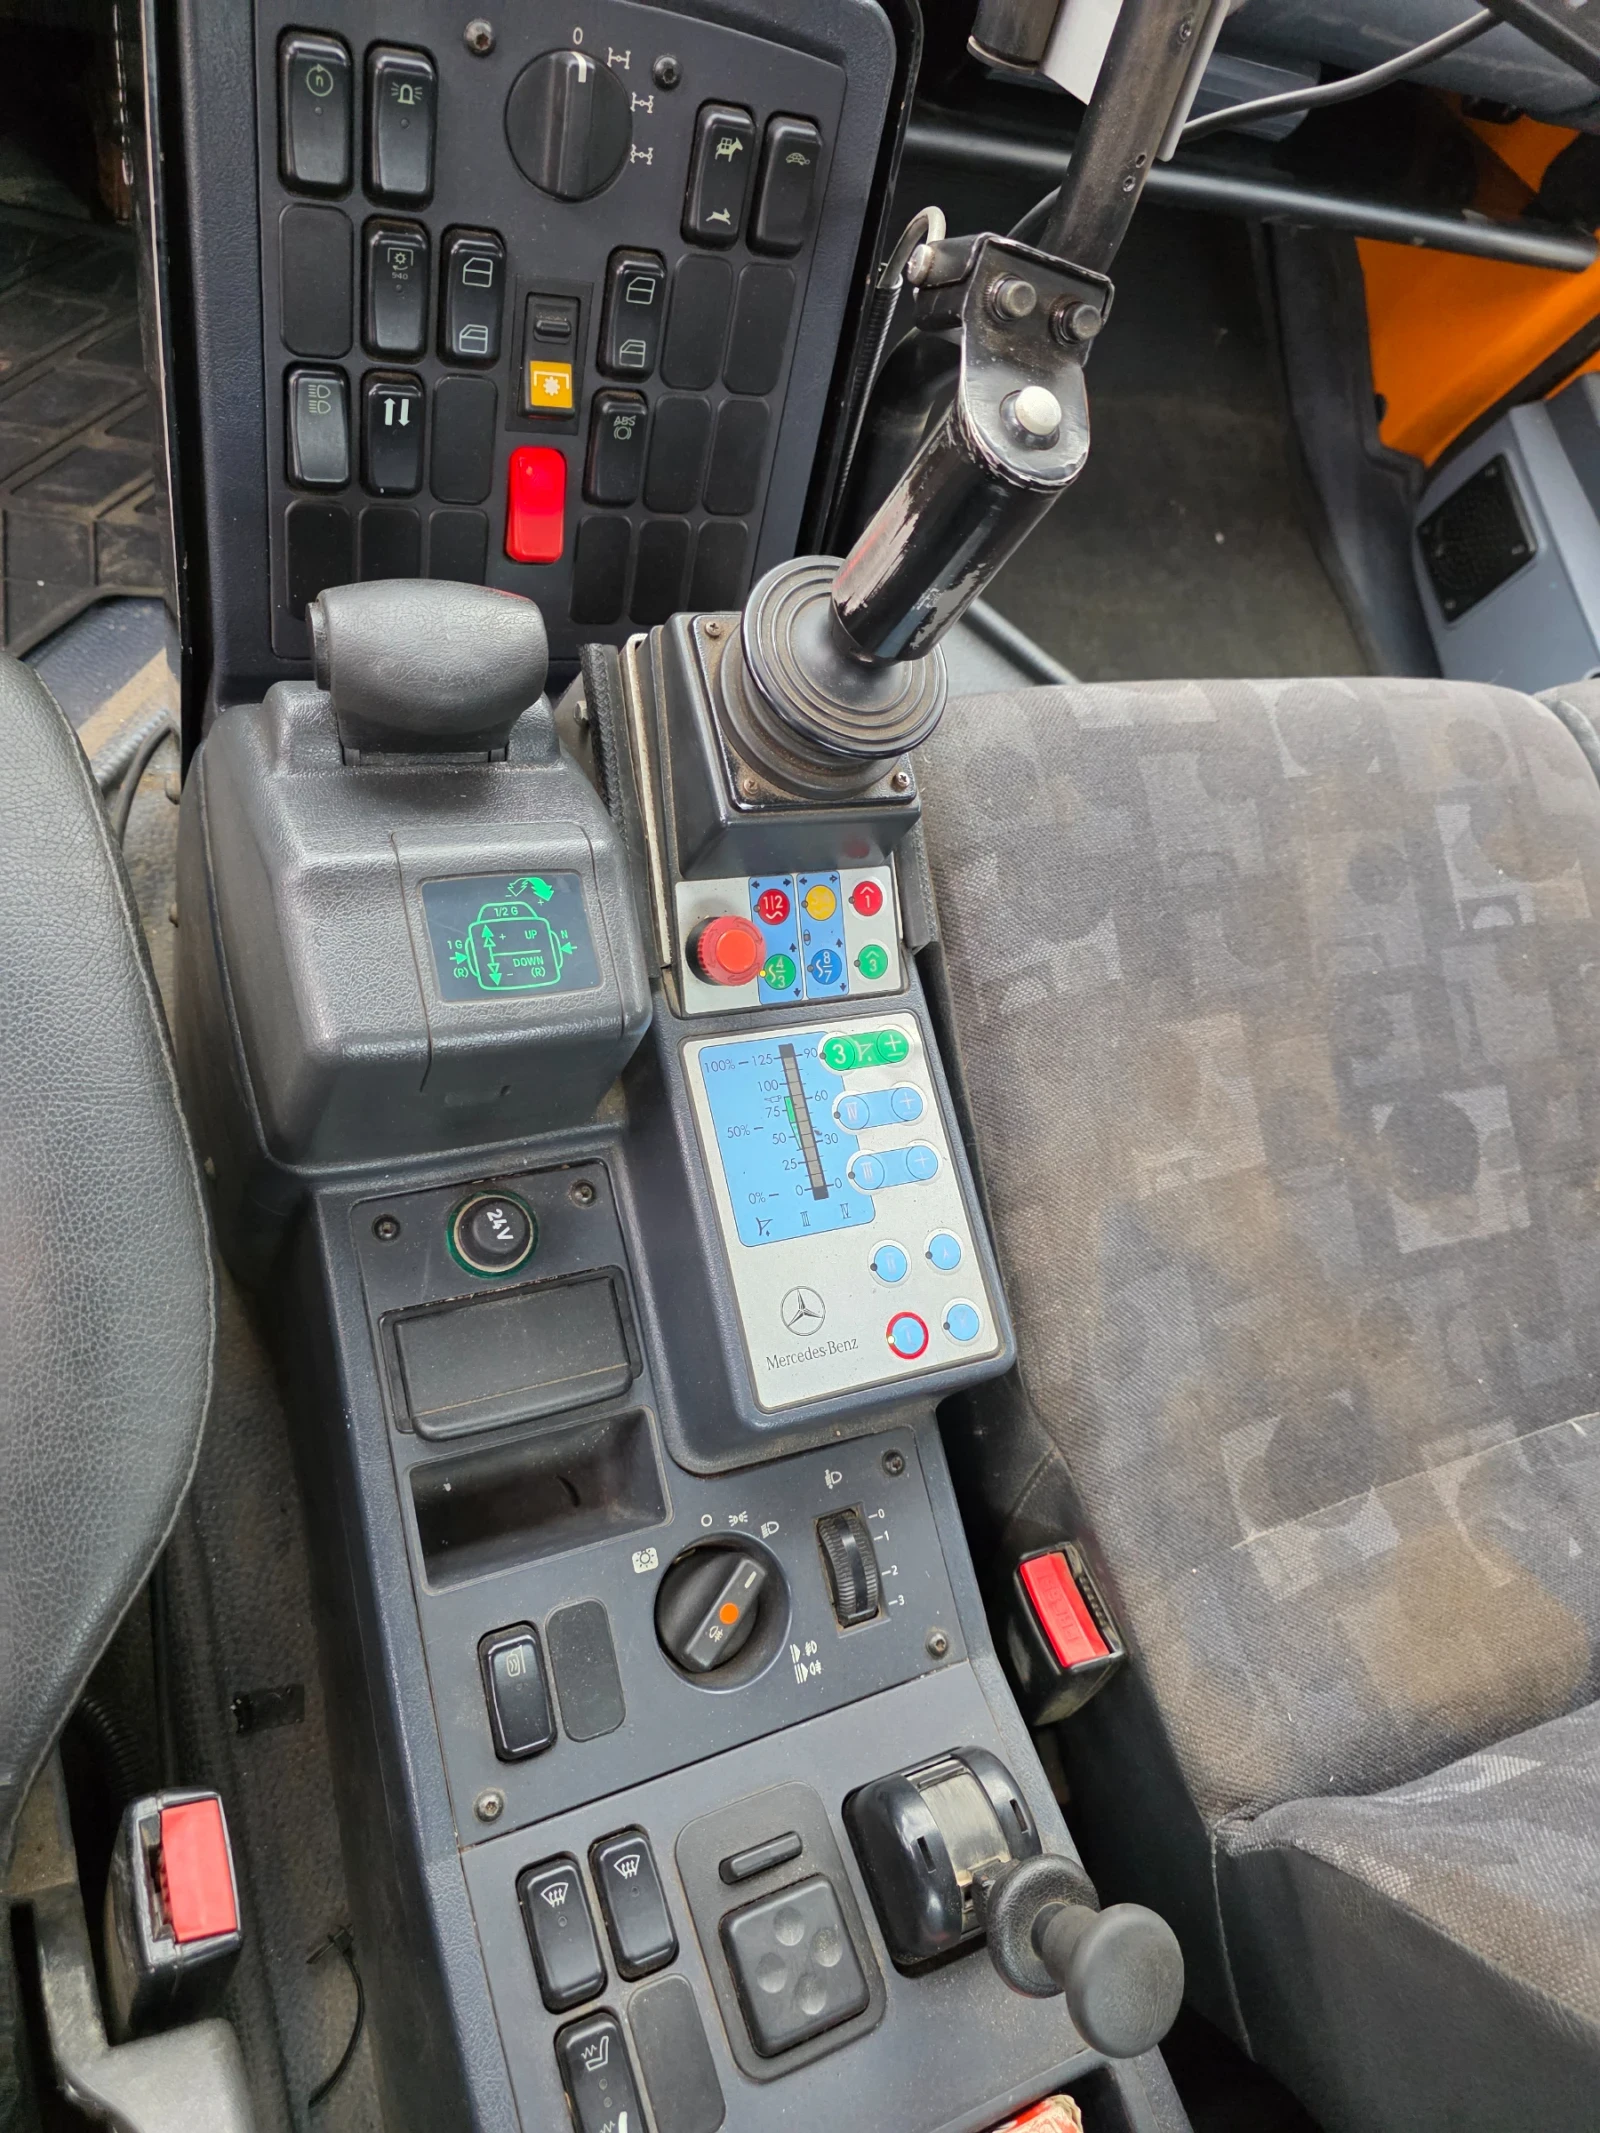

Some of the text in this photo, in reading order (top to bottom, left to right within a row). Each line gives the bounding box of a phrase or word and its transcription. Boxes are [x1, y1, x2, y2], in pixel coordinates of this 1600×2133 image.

[613, 415, 637, 427] ABS
[864, 894, 872, 909] 1
[493, 906, 519, 917] 1/2 G
[524, 929, 538, 940] UP
[560, 929, 569, 939] N
[455, 940, 463, 949] G
[512, 955, 545, 968] DOWN
[775, 957, 785, 969] 4
[822, 951, 831, 964] 8
[869, 958, 878, 973] 3
[453, 967, 469, 979] (R)
[530, 967, 546, 978] (R)
[824, 970, 834, 983] 7
[777, 975, 786, 989] 3
[803, 1047, 818, 1059] 90
[831, 1043, 847, 1065] 3
[704, 1053, 773, 1074] 100% 125
[757, 1079, 779, 1092] 100
[814, 1089, 829, 1102] 60
[765, 1105, 781, 1119] 75
[727, 1124, 751, 1139] 50%
[772, 1132, 787, 1145] 50
[824, 1132, 839, 1145] 30
[782, 1157, 798, 1171] 25
[834, 1177, 843, 1189] 0
[795, 1185, 804, 1196] 0
[748, 1191, 766, 1205] 0%
[486, 1208, 514, 1240] 24V
[765, 1337, 859, 1371] Mercedes-Benz
[877, 1508, 886, 1519] 0
[884, 1530, 890, 1541] 1
[891, 1564, 899, 1576] 2
[897, 1594, 906, 1606] 3
